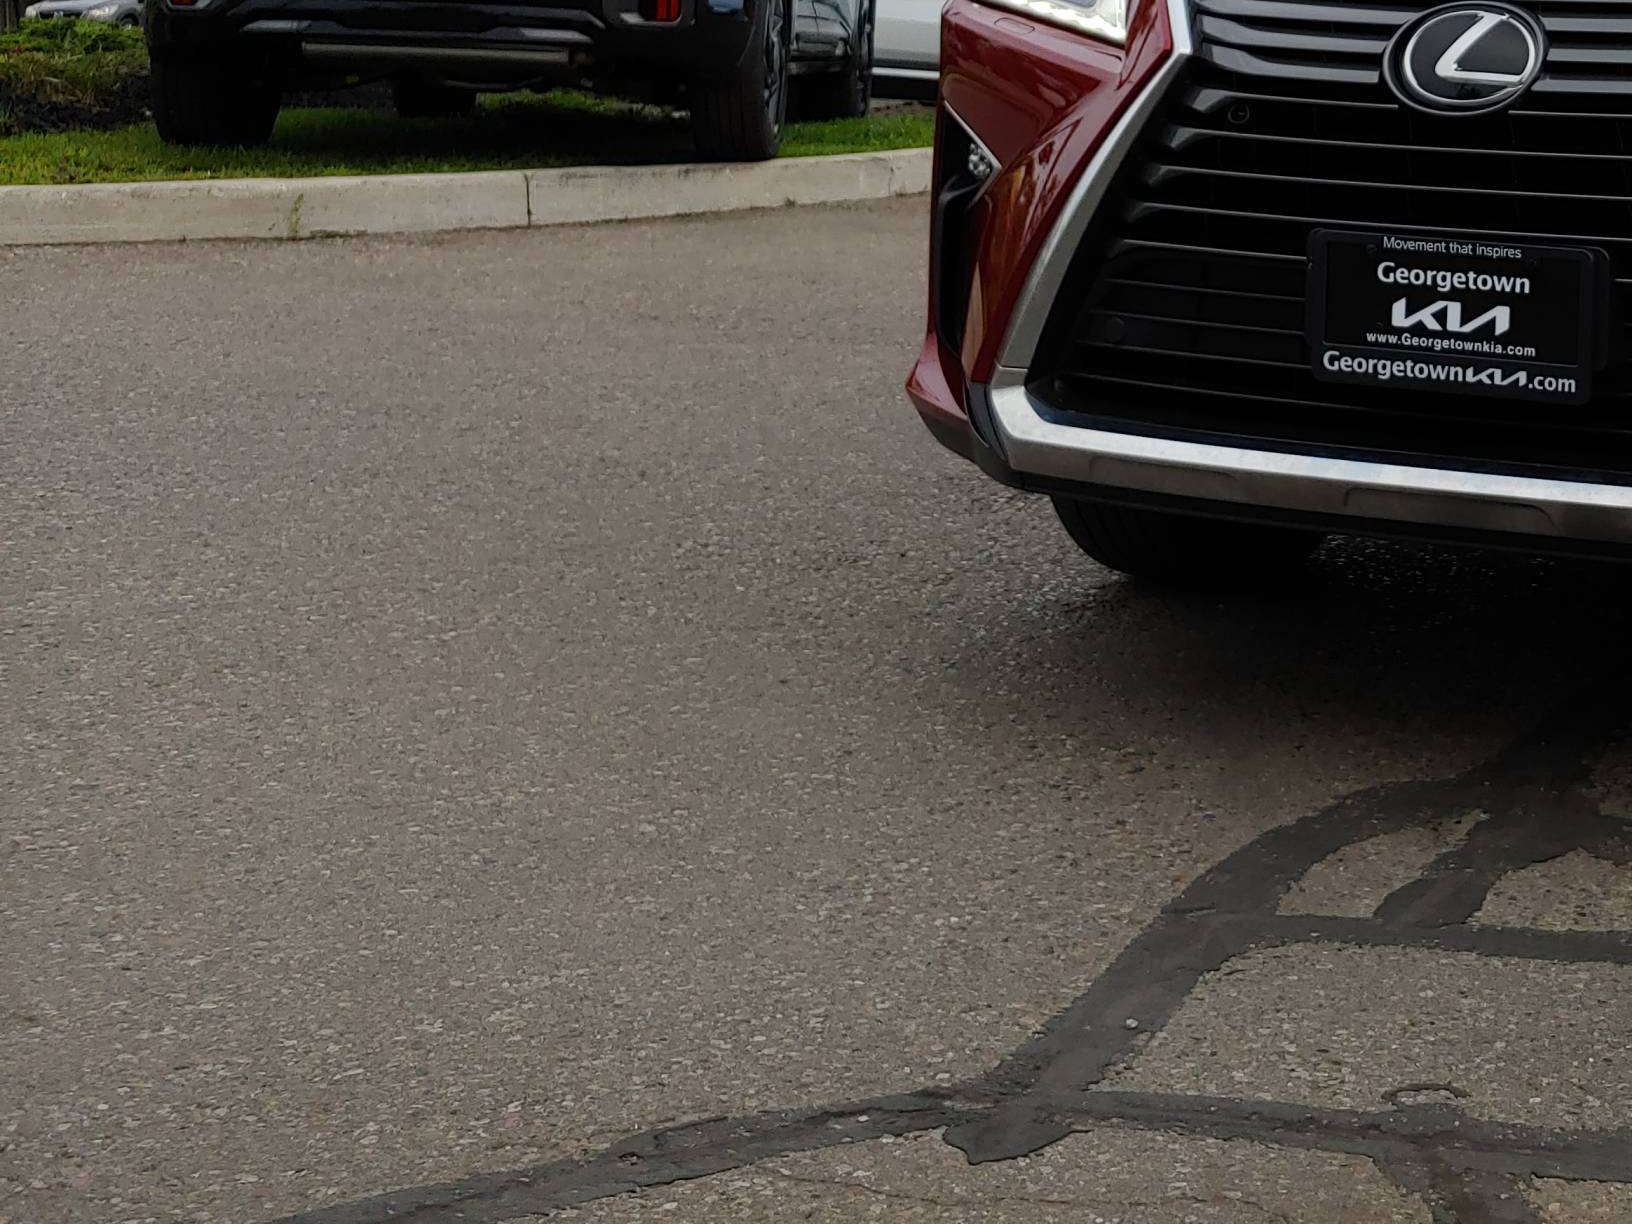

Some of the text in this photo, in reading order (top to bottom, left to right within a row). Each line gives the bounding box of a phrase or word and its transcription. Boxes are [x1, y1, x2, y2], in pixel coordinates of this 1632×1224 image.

[1383, 236, 1522, 259] Movement that inspires
[1377, 261, 1530, 293] Georgetown
[1391, 297, 1511, 336] KIA
[1366, 332, 1536, 357] www.Georgetownkia.com
